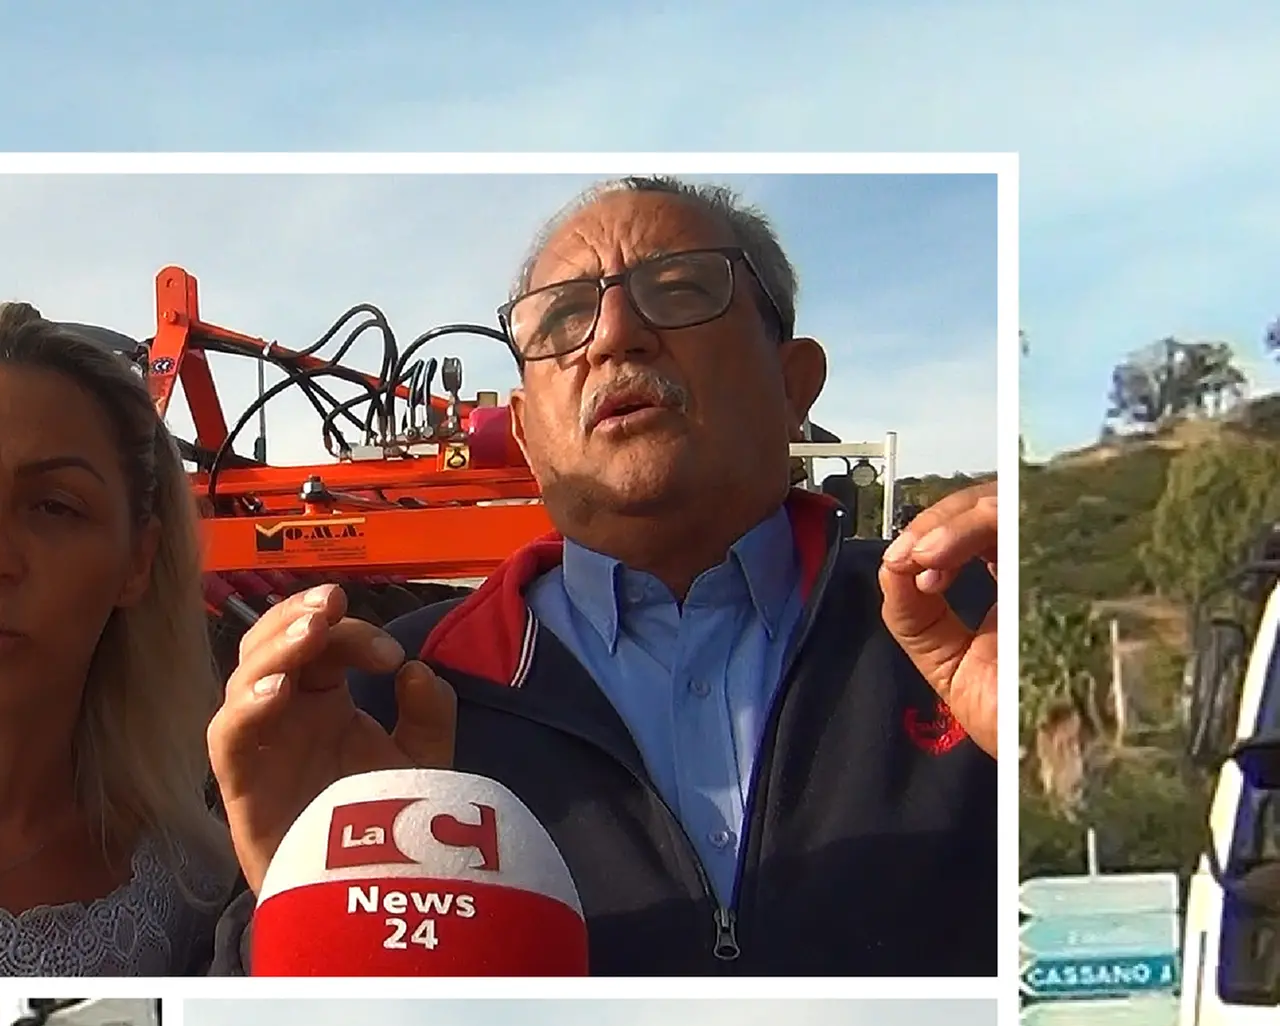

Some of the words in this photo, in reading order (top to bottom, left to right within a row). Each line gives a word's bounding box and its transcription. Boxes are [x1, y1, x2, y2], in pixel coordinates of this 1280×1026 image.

[342, 824, 386, 848] La
[347, 885, 476, 918] News
[383, 918, 439, 950] 24
[1027, 962, 1151, 986] CASSANO
